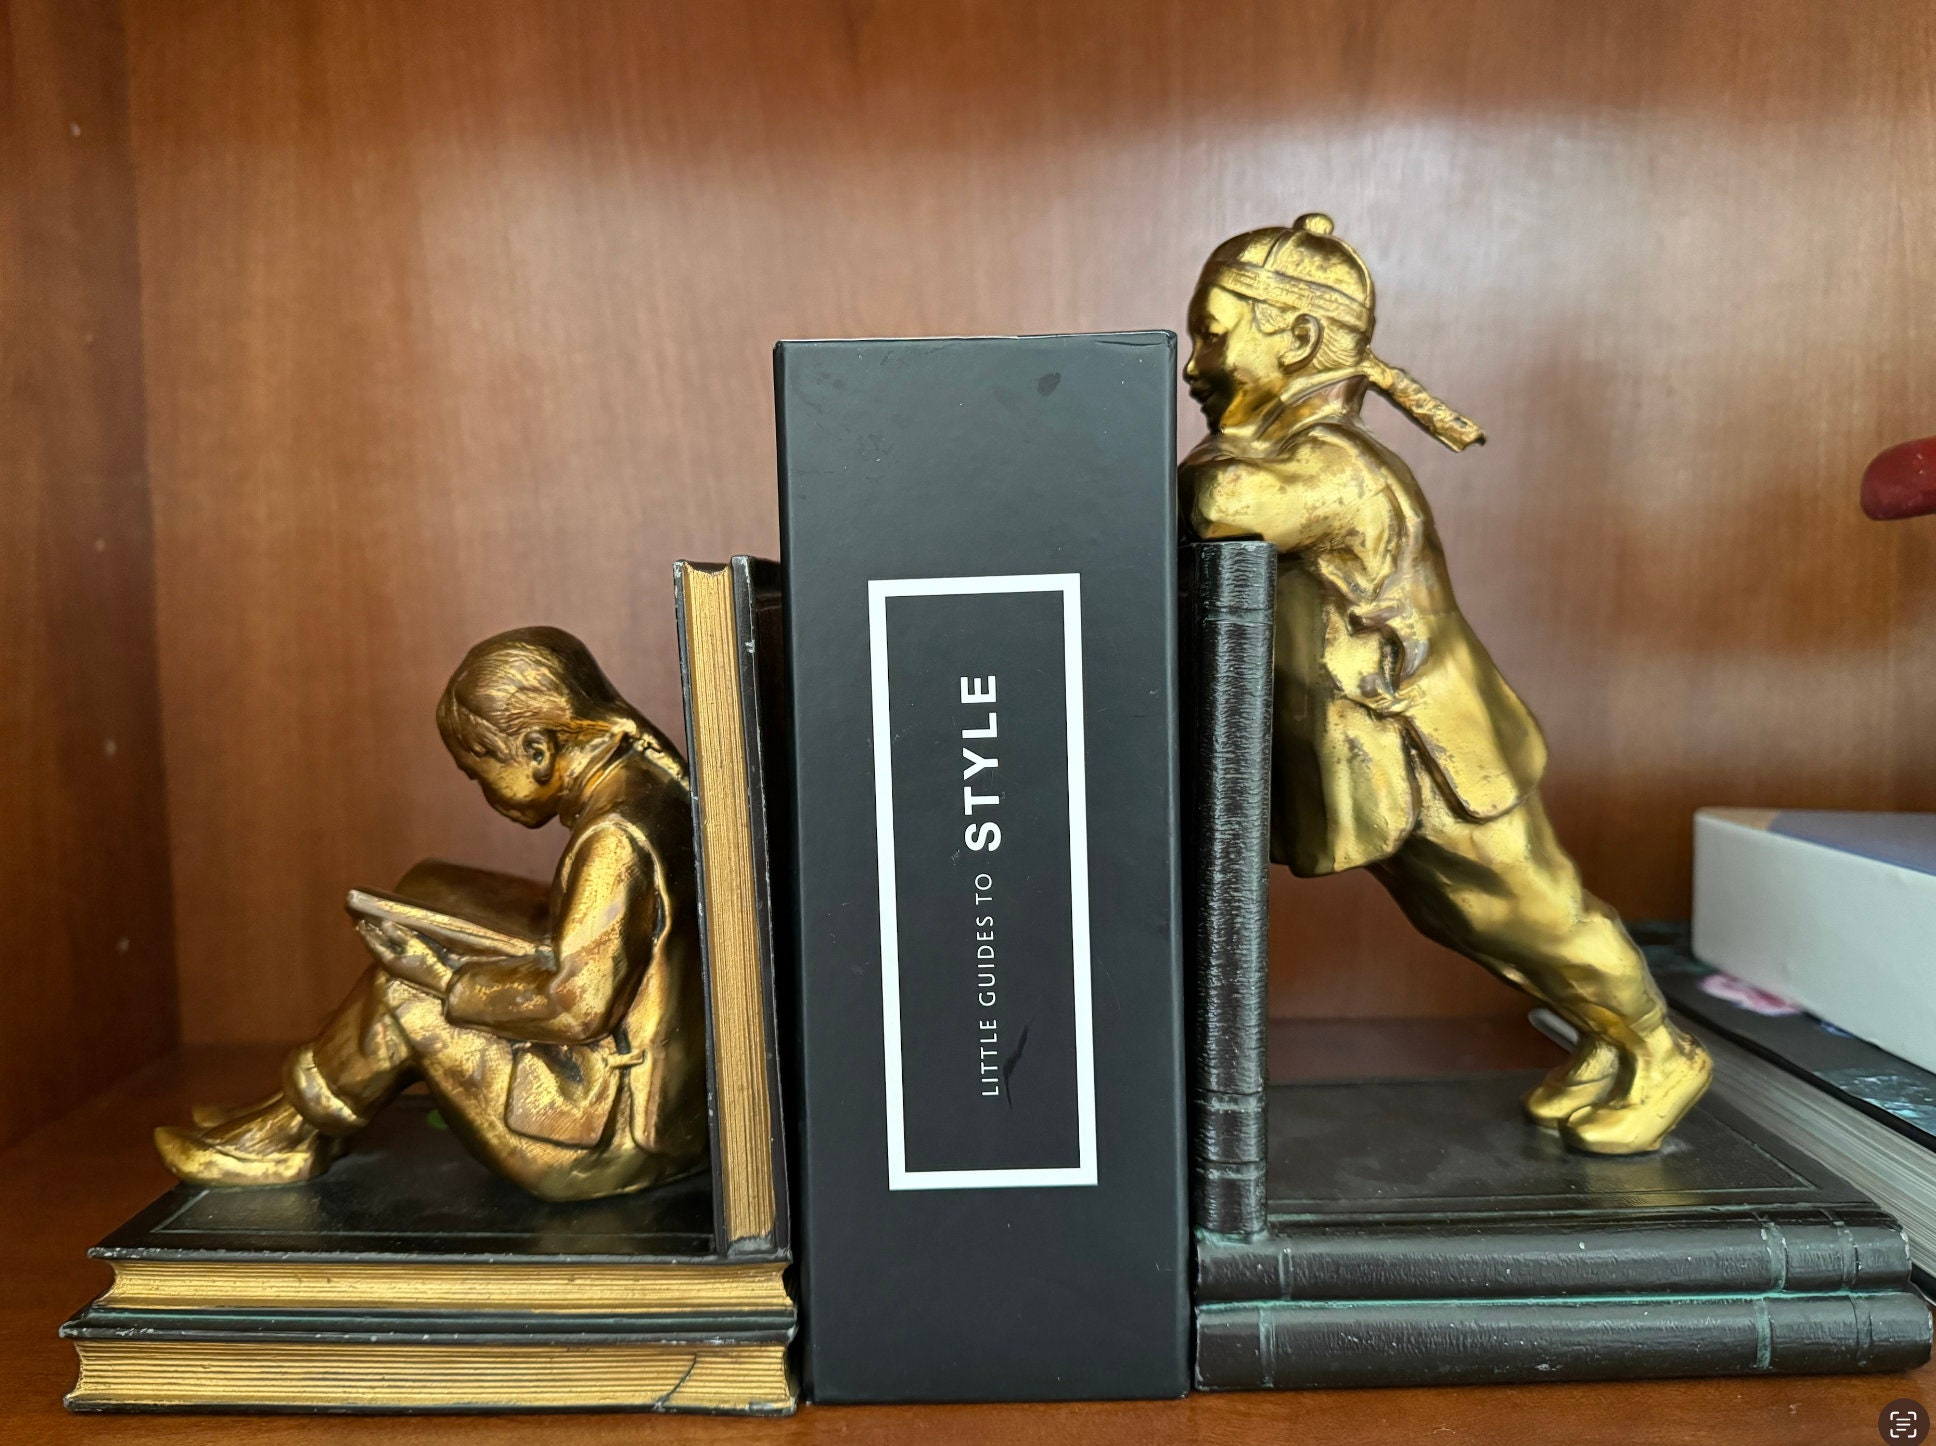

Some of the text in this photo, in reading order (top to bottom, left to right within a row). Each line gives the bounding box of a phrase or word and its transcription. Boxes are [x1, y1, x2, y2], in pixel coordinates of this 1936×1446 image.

[960, 674, 1002, 1097] LITTLE GUIDES TO STYLE
